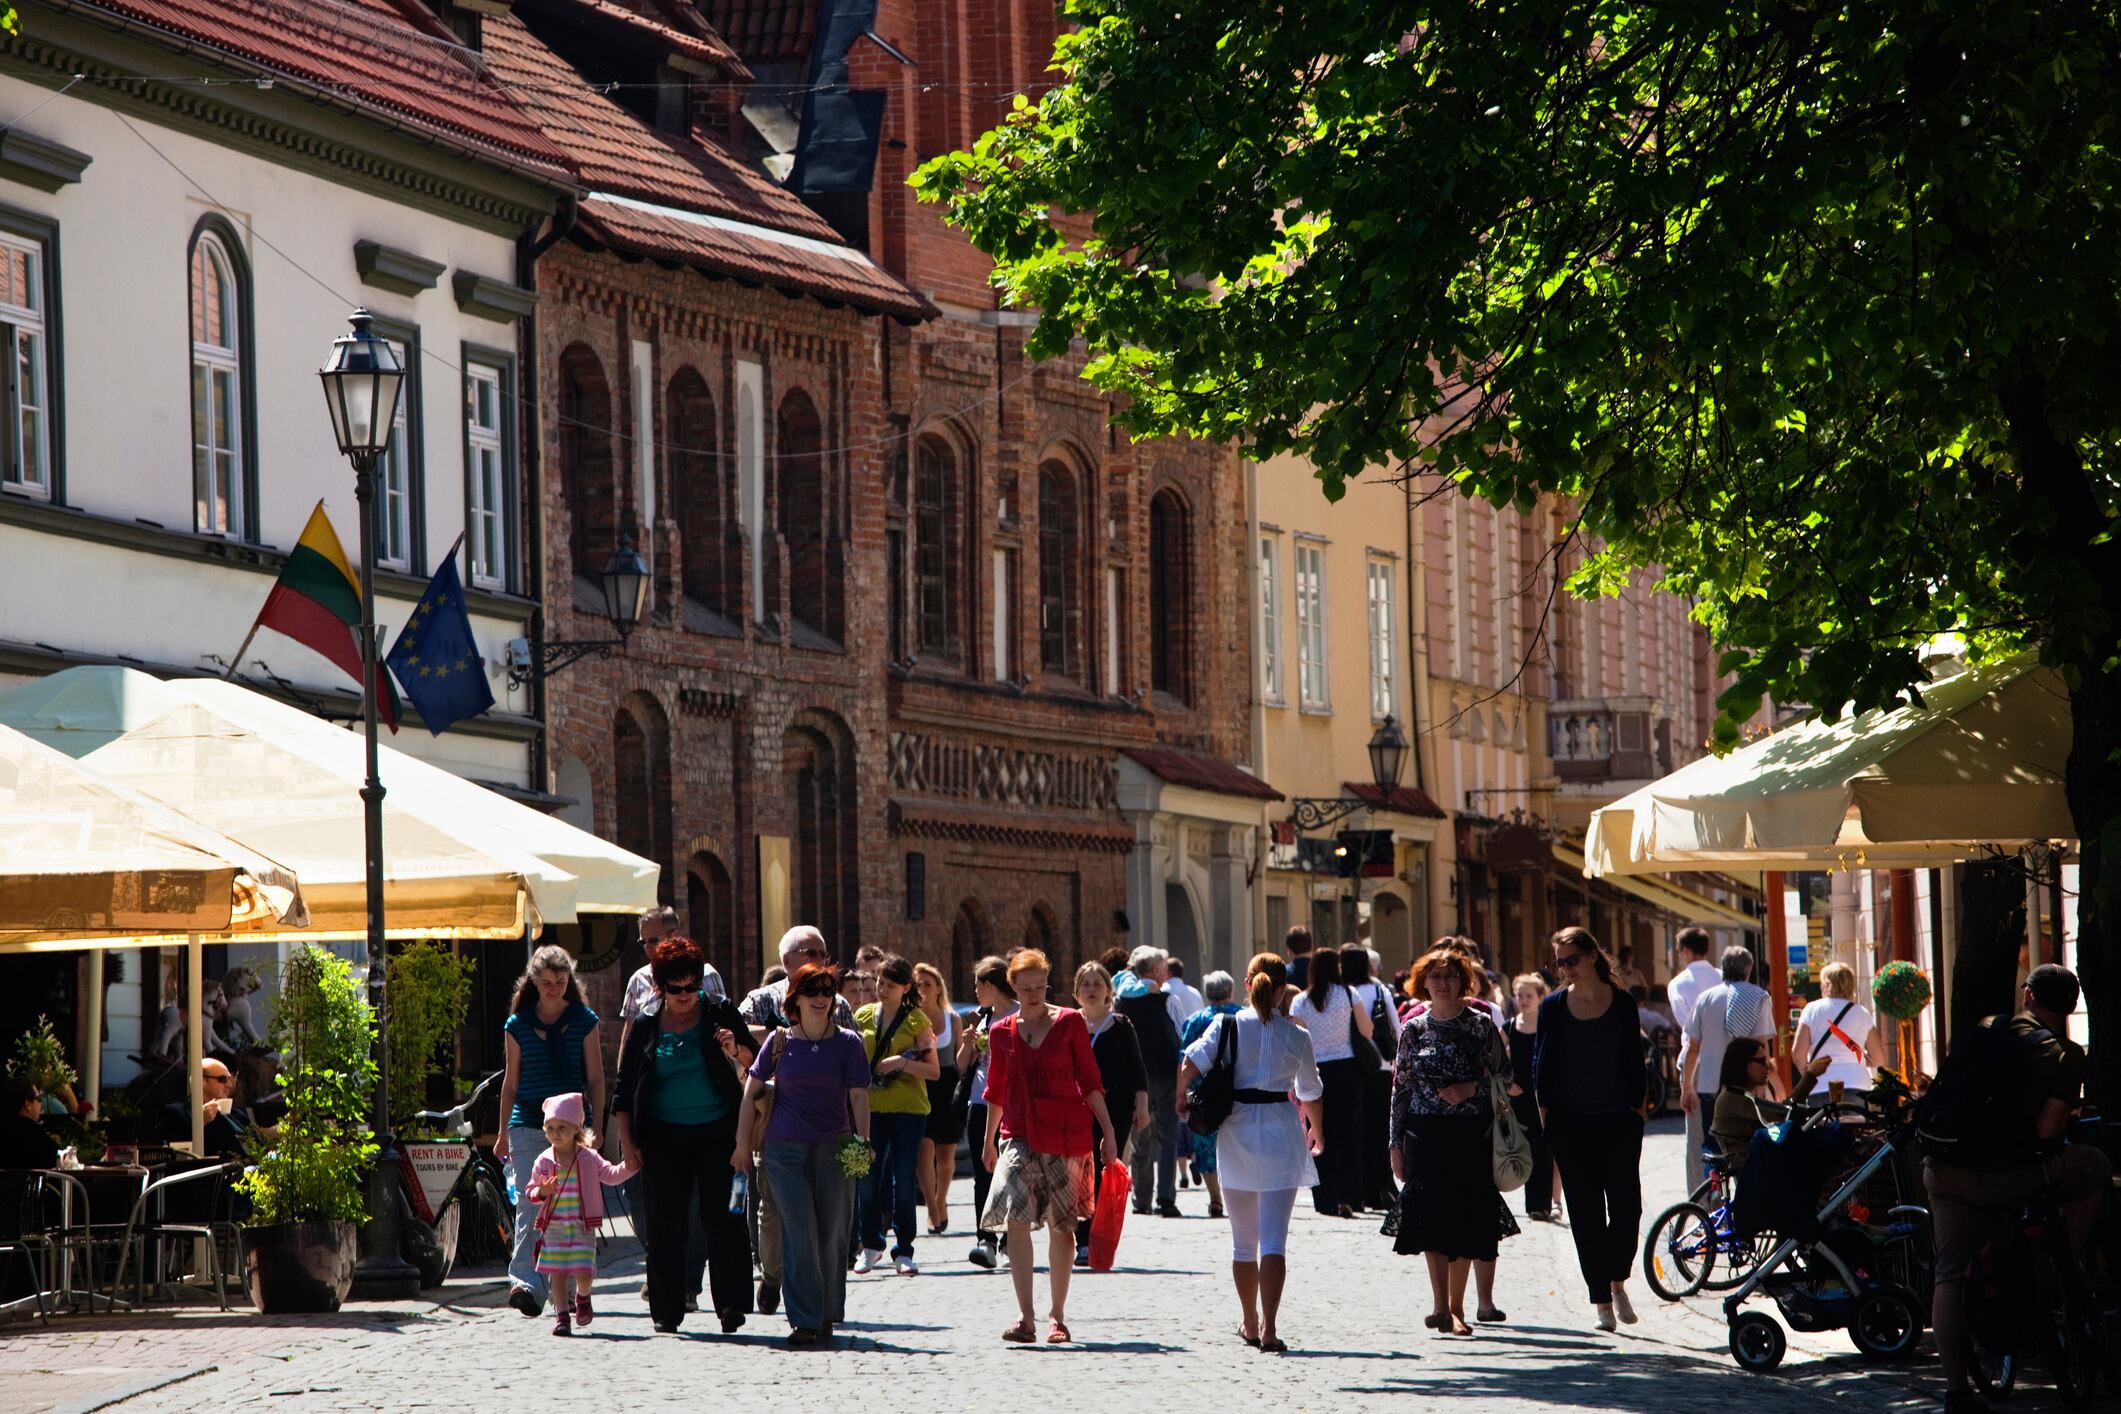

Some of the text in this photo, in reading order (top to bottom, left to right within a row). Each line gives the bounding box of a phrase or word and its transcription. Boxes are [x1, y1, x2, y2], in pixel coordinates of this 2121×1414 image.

[411, 1148, 464, 1160] RENT A BIKE
[416, 1163, 459, 1171] TOURS BY BIKE
